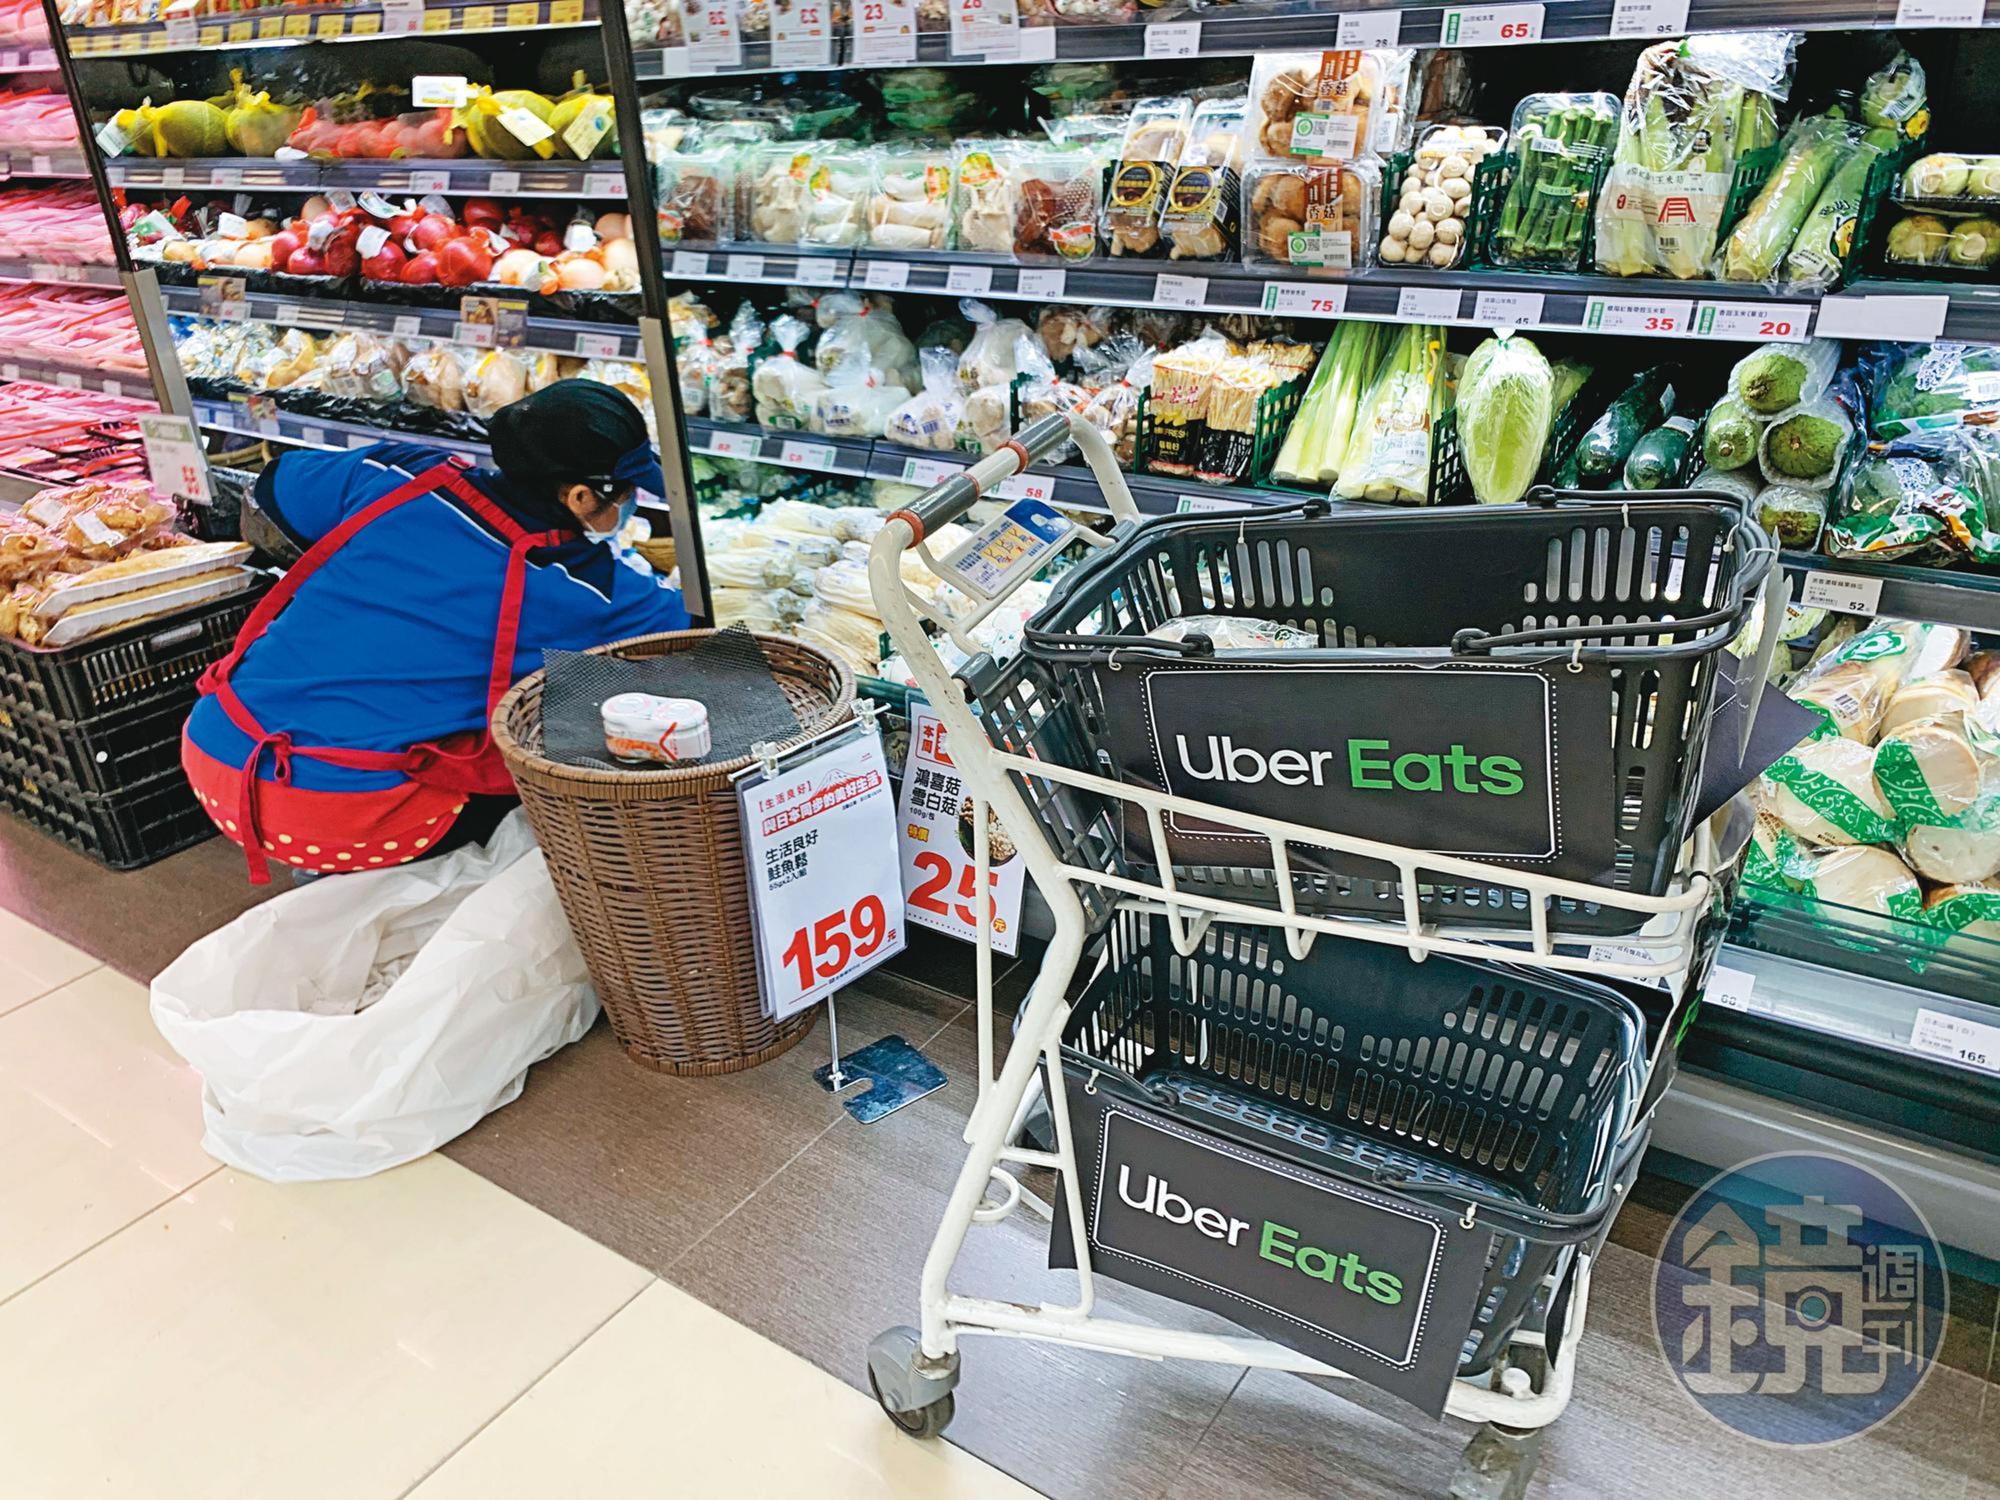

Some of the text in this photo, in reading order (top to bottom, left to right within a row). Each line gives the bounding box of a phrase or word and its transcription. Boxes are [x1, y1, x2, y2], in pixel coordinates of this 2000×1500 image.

[864, 4, 884, 20] 23
[1501, 23, 1529, 39] 65
[1657, 25, 1673, 34] 95
[1320, 80, 1349, 97] 香菇
[1309, 204, 1336, 220] 香菇
[1311, 299, 1334, 312] 75
[1645, 317, 1675, 331] 35
[1759, 321, 1791, 336] 20
[1025, 488, 1045, 498] 58
[1848, 602, 1866, 611] 52
[1175, 734, 1525, 796] Uber Eats
[914, 766, 962, 797] 鴻喜菇
[911, 787, 958, 818] 雪白菇
[907, 823, 931, 843] 特價
[765, 828, 819, 866] 生活良好
[767, 851, 808, 883] 鮭魚鬆
[907, 850, 999, 928] 25
[782, 894, 887, 992] 159
[1959, 1049, 1987, 1065] 165
[1117, 1163, 1404, 1306] Uber Eats
